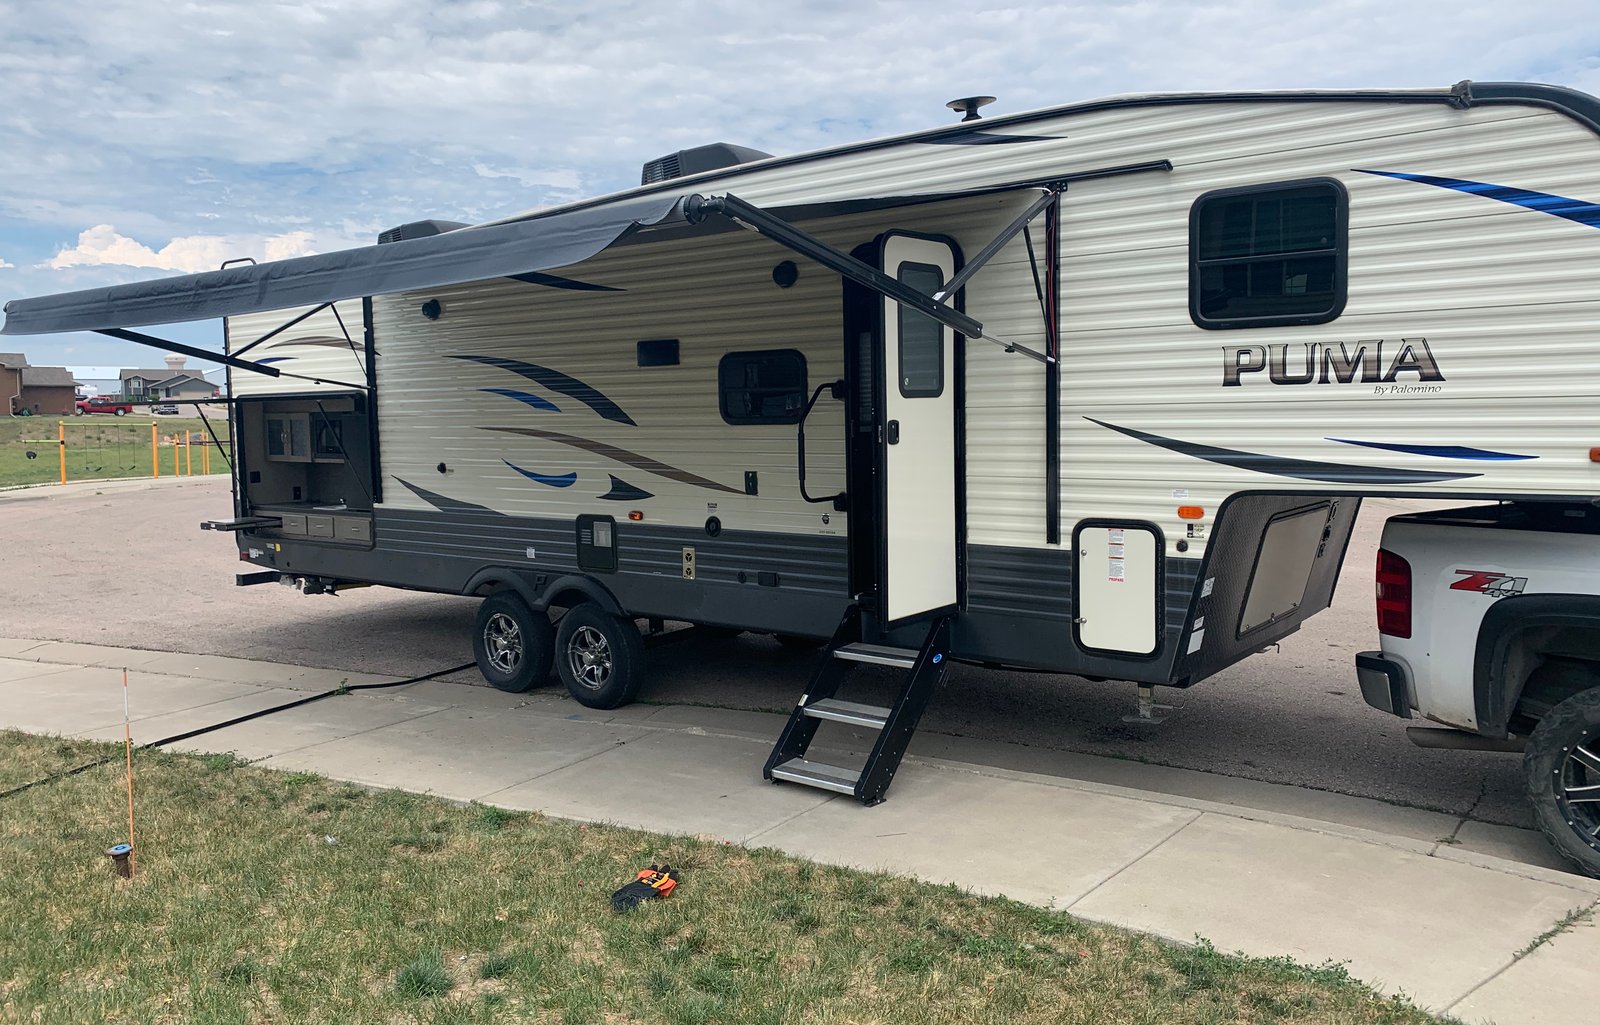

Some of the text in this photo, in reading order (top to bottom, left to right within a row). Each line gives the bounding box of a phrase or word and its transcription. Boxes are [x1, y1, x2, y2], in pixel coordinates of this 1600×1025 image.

[1221, 337, 1447, 387] PUMA
[1374, 384, 1442, 396] By Palomino
[1450, 569, 1528, 593] Z71
